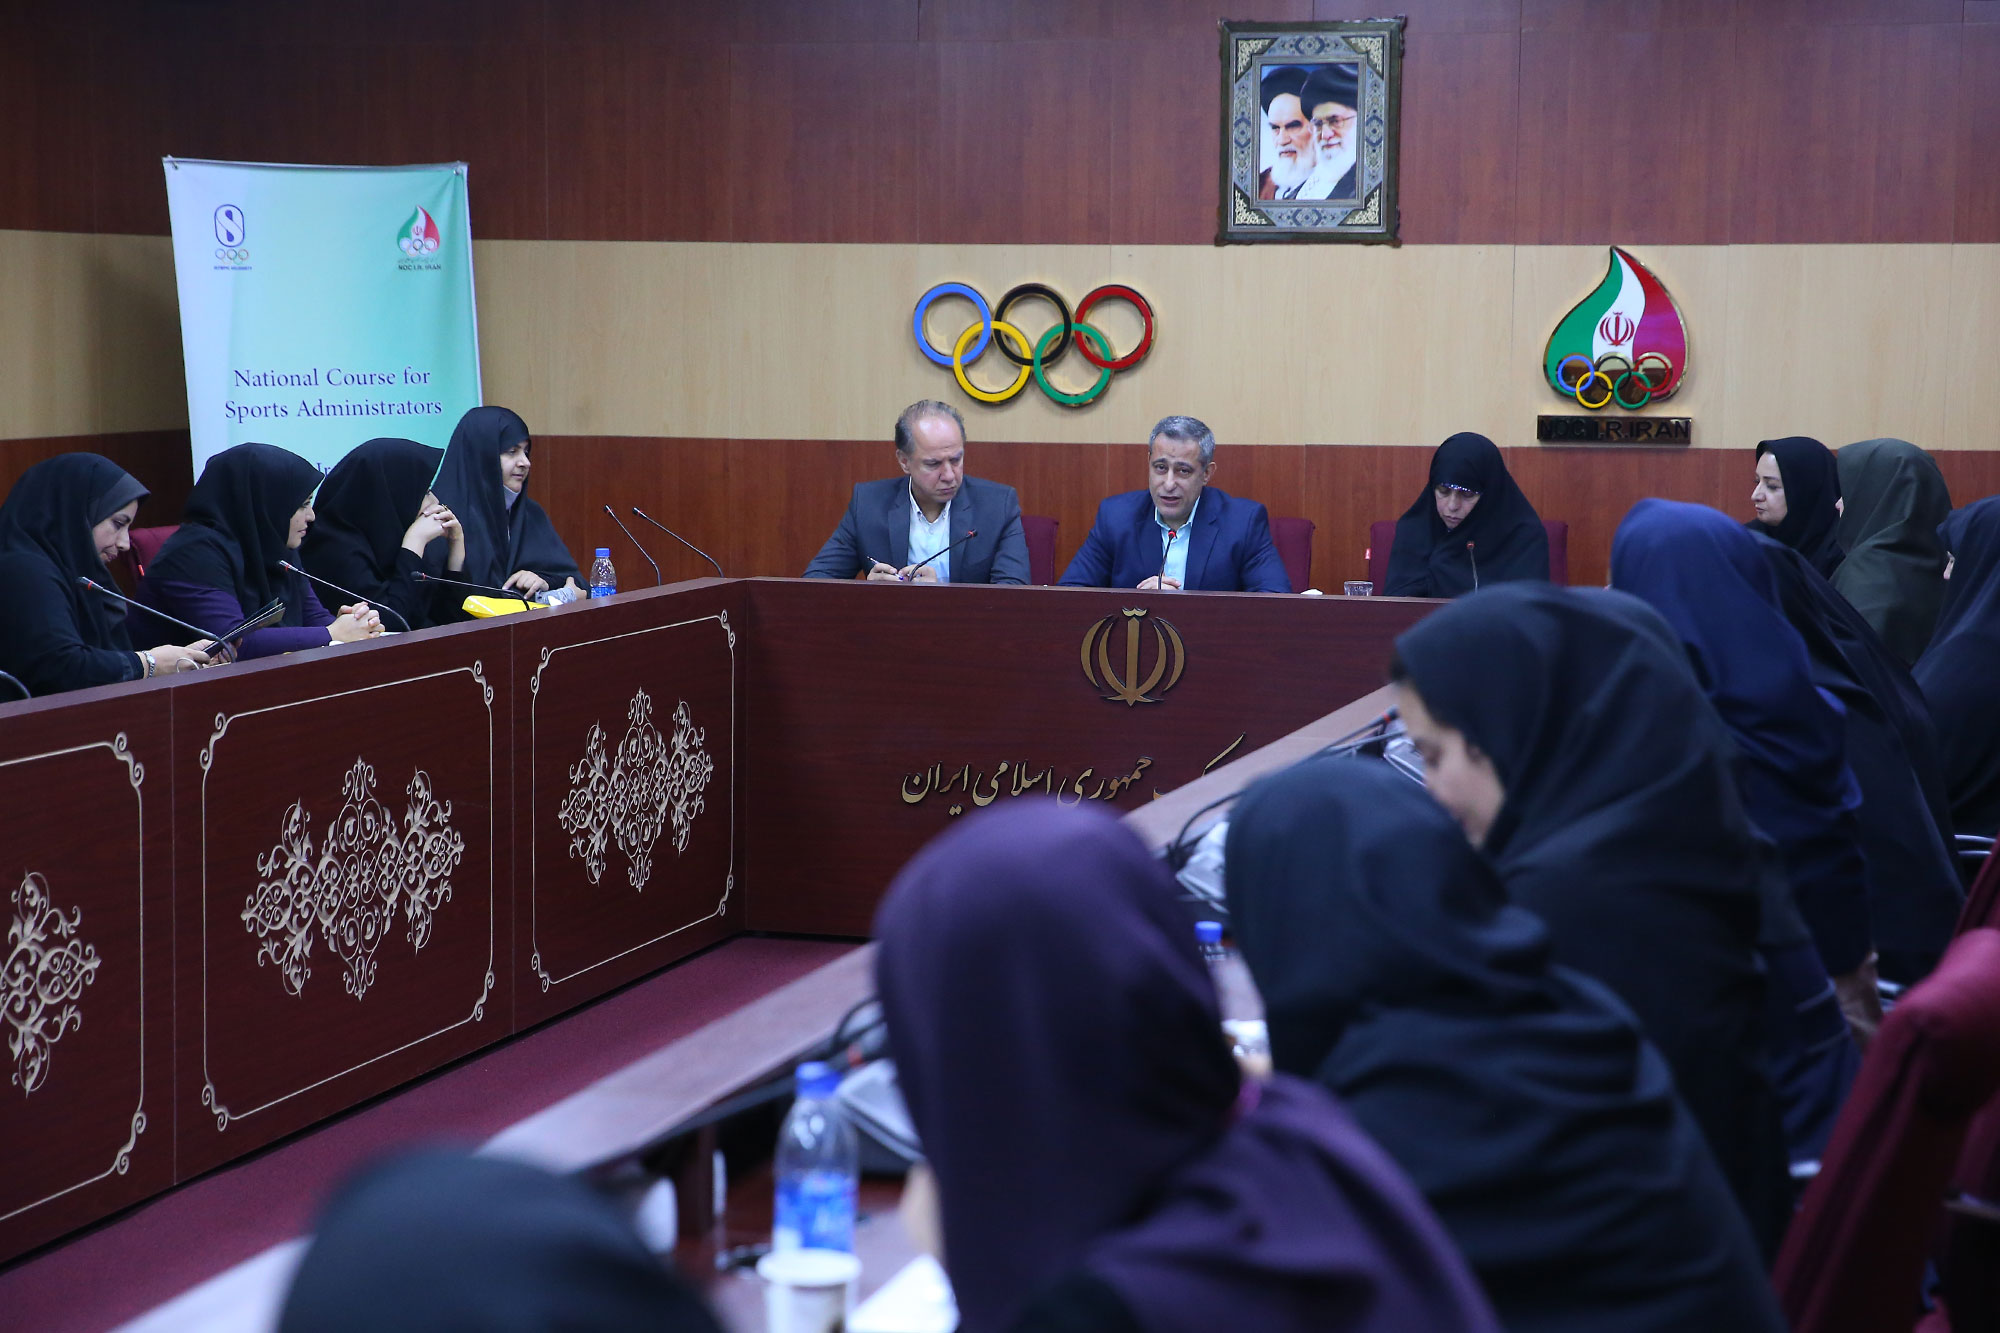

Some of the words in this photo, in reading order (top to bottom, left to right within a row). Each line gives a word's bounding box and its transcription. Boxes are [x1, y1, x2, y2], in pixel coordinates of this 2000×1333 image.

[234, 368, 319, 387] National
[326, 367, 396, 386] Course
[403, 366, 430, 385] for
[225, 400, 288, 424] Sports
[297, 398, 442, 417] Administrators
[1541, 419, 1586, 439] NOC
[901, 760, 969, 815] ایران
[973, 759, 1054, 807] اسلامی
[1056, 756, 1152, 808] جمهوری
